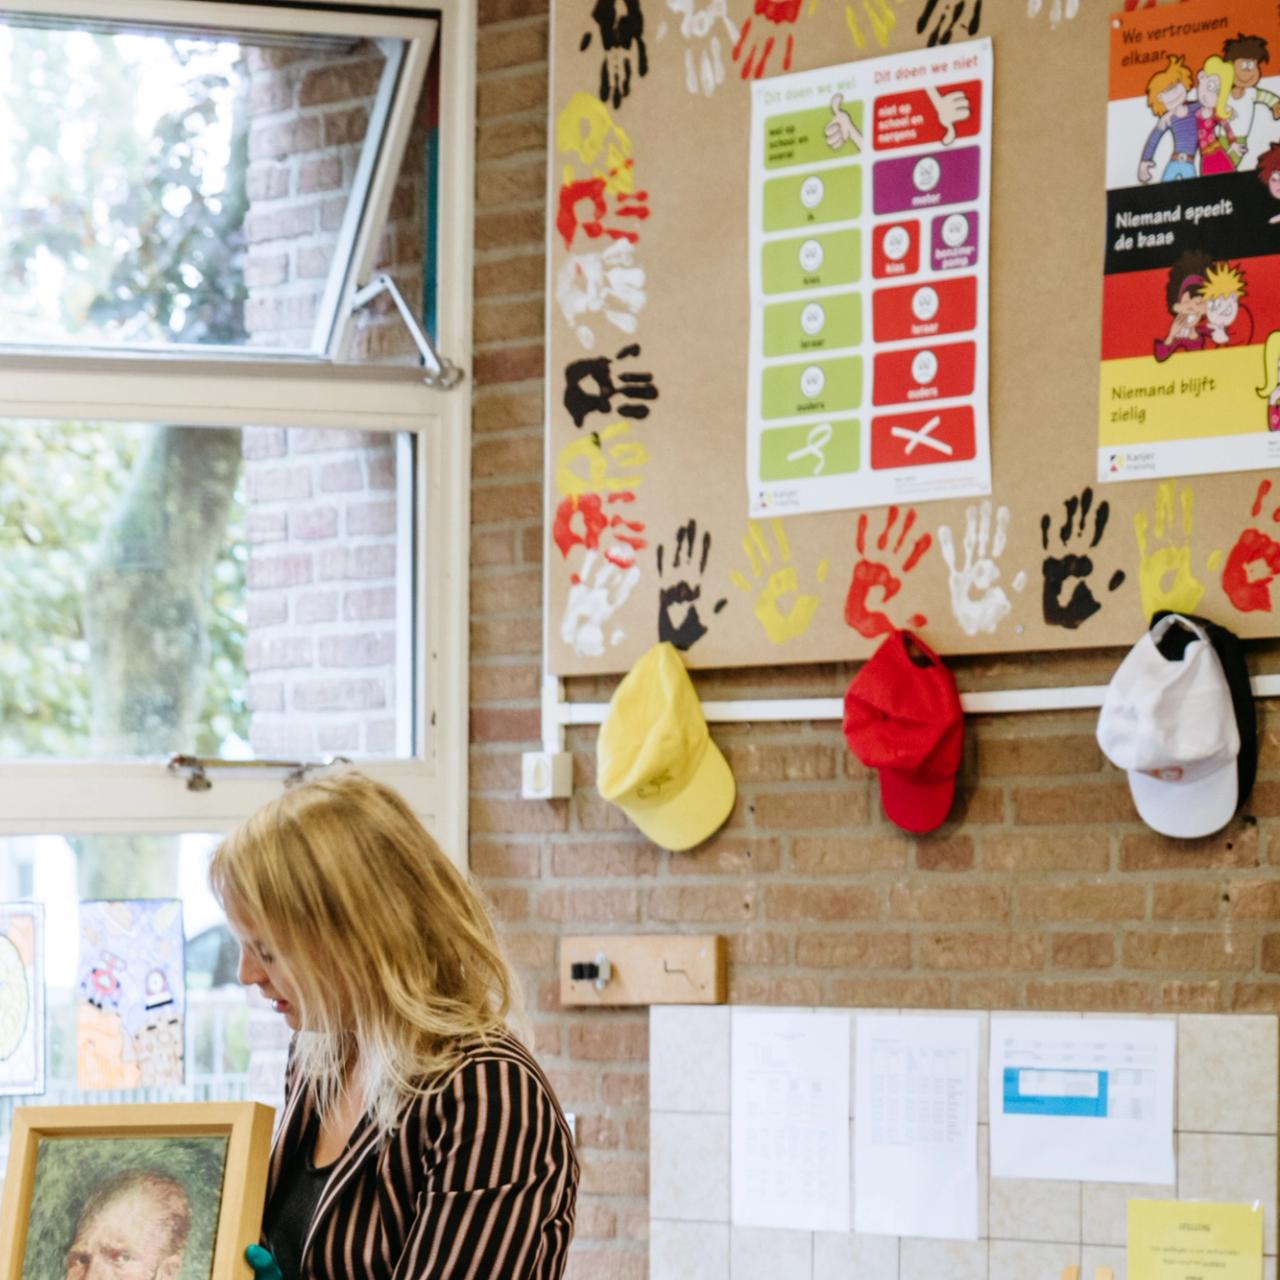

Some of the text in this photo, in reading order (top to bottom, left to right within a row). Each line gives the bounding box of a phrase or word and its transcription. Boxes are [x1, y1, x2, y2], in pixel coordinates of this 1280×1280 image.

[1123, 16, 1228, 44] We vertrouwen
[895, 65, 927, 80] doen
[931, 62, 948, 73] we
[953, 55, 978, 70] niet
[1121, 50, 1167, 66] elkaar
[1115, 199, 1233, 229] Niemand speelt
[1114, 231, 1175, 251] de baas
[1112, 376, 1216, 400] Niemand blijft
[1110, 407, 1147, 424] zielig
